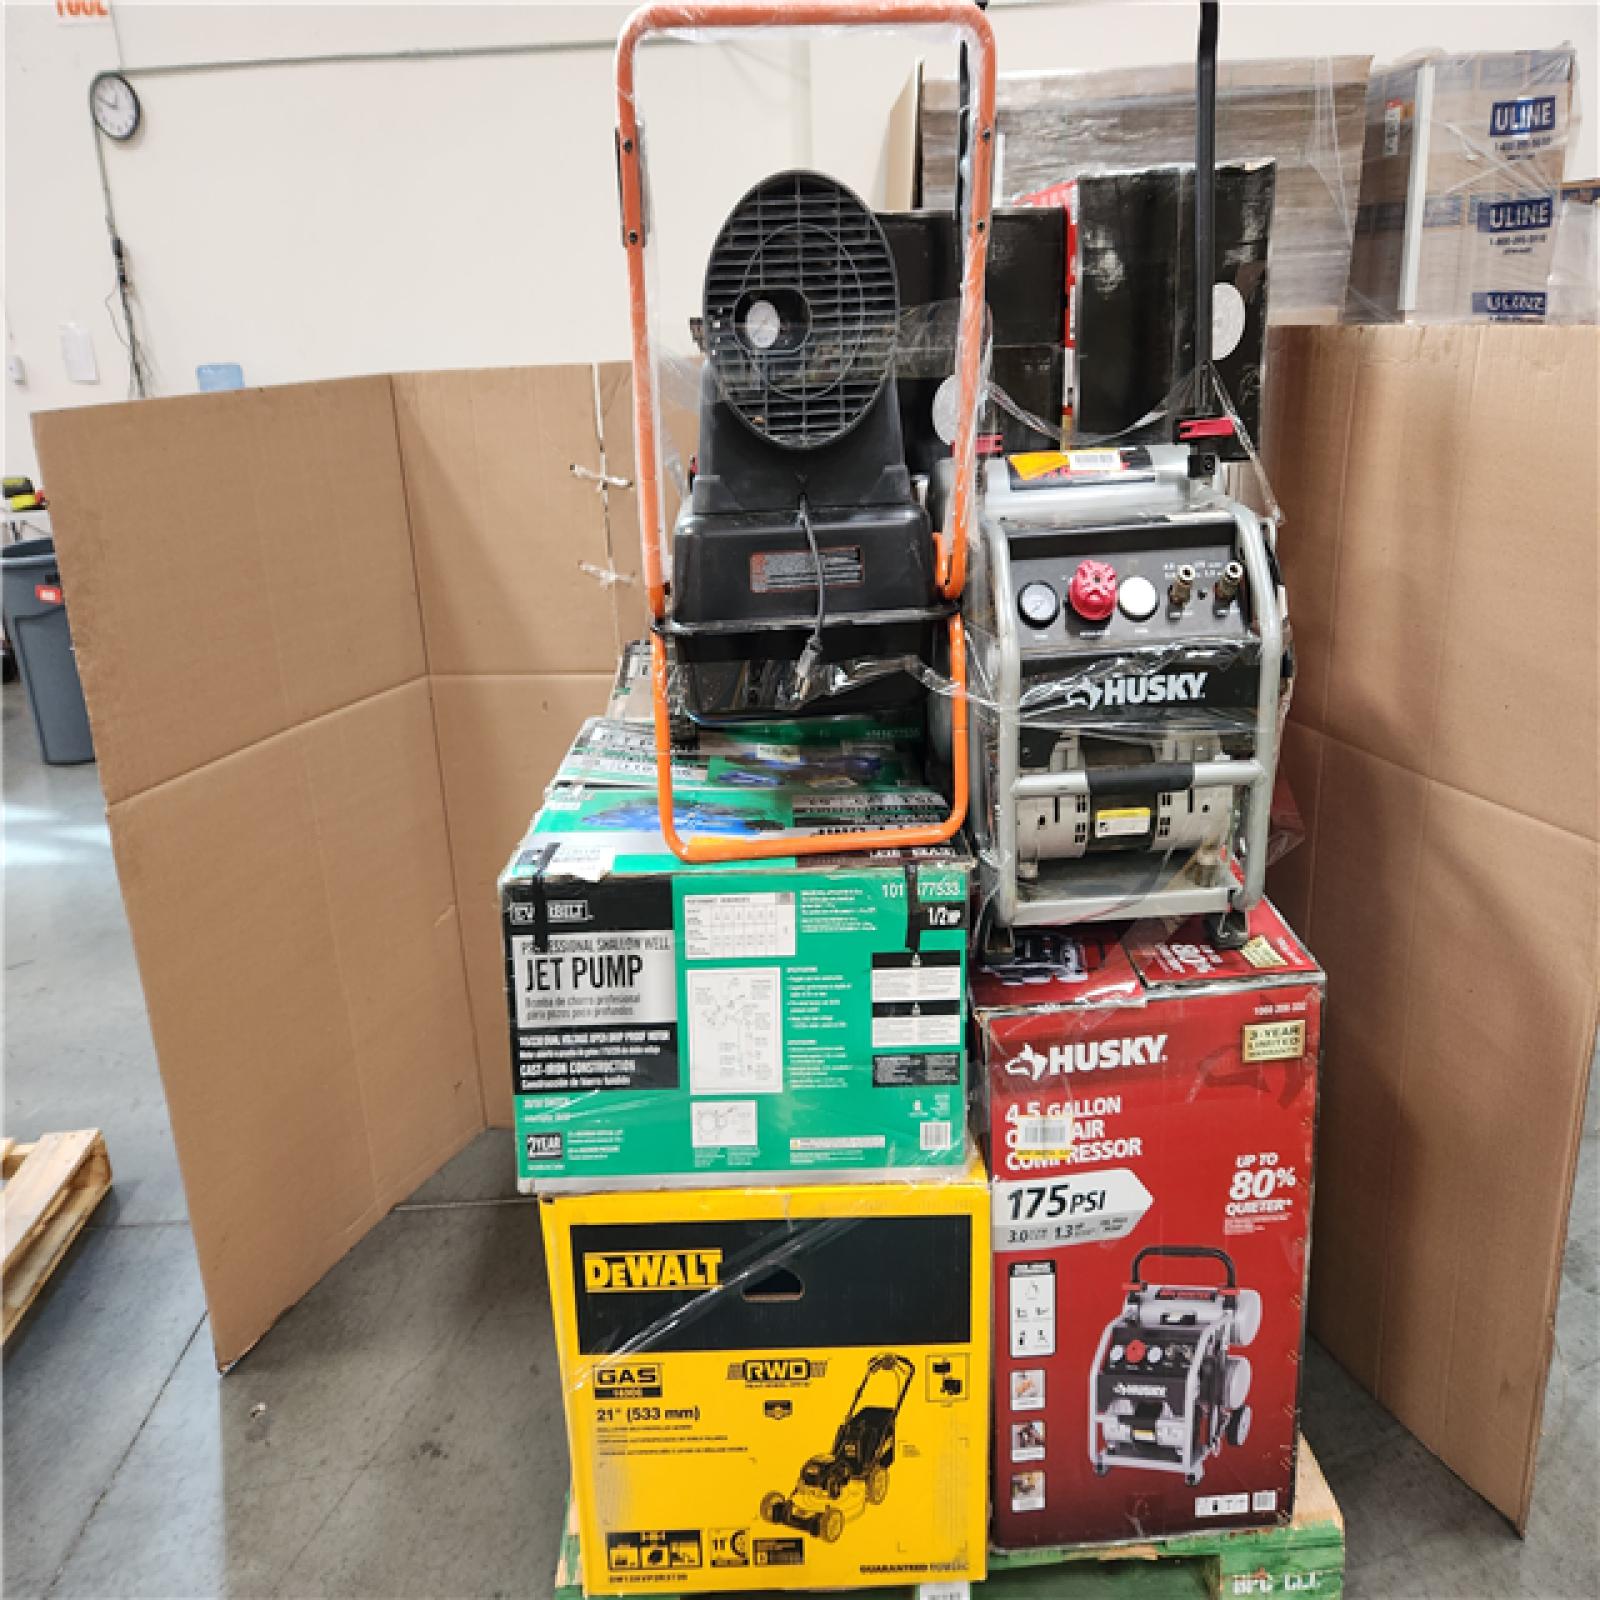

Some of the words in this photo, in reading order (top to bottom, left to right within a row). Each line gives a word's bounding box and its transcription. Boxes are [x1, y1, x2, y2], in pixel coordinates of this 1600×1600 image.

[1494, 101, 1551, 131] ULINE
[1488, 201, 1549, 228] ULINE
[1104, 672, 1207, 706] HUSKY
[644, 935, 671, 951] WELL
[525, 956, 563, 991] JET
[572, 954, 643, 989] PUMP
[1050, 1034, 1168, 1075] HUSKY
[1046, 1095, 1122, 1117] GALLON
[1072, 1119, 1106, 1140] AIR
[1235, 1155, 1258, 1168] UP
[1259, 1153, 1279, 1166] TO
[1228, 1167, 1297, 1201] 80%
[1007, 1184, 1070, 1220] 175
[1069, 1188, 1106, 1214] PSI
[585, 1253, 723, 1287] DEWALT
[597, 1368, 656, 1384] GAS
[746, 1362, 808, 1378] RWD
[596, 1408, 622, 1421] 21"
[626, 1406, 661, 1424] (533
[664, 1404, 701, 1422] mm)
